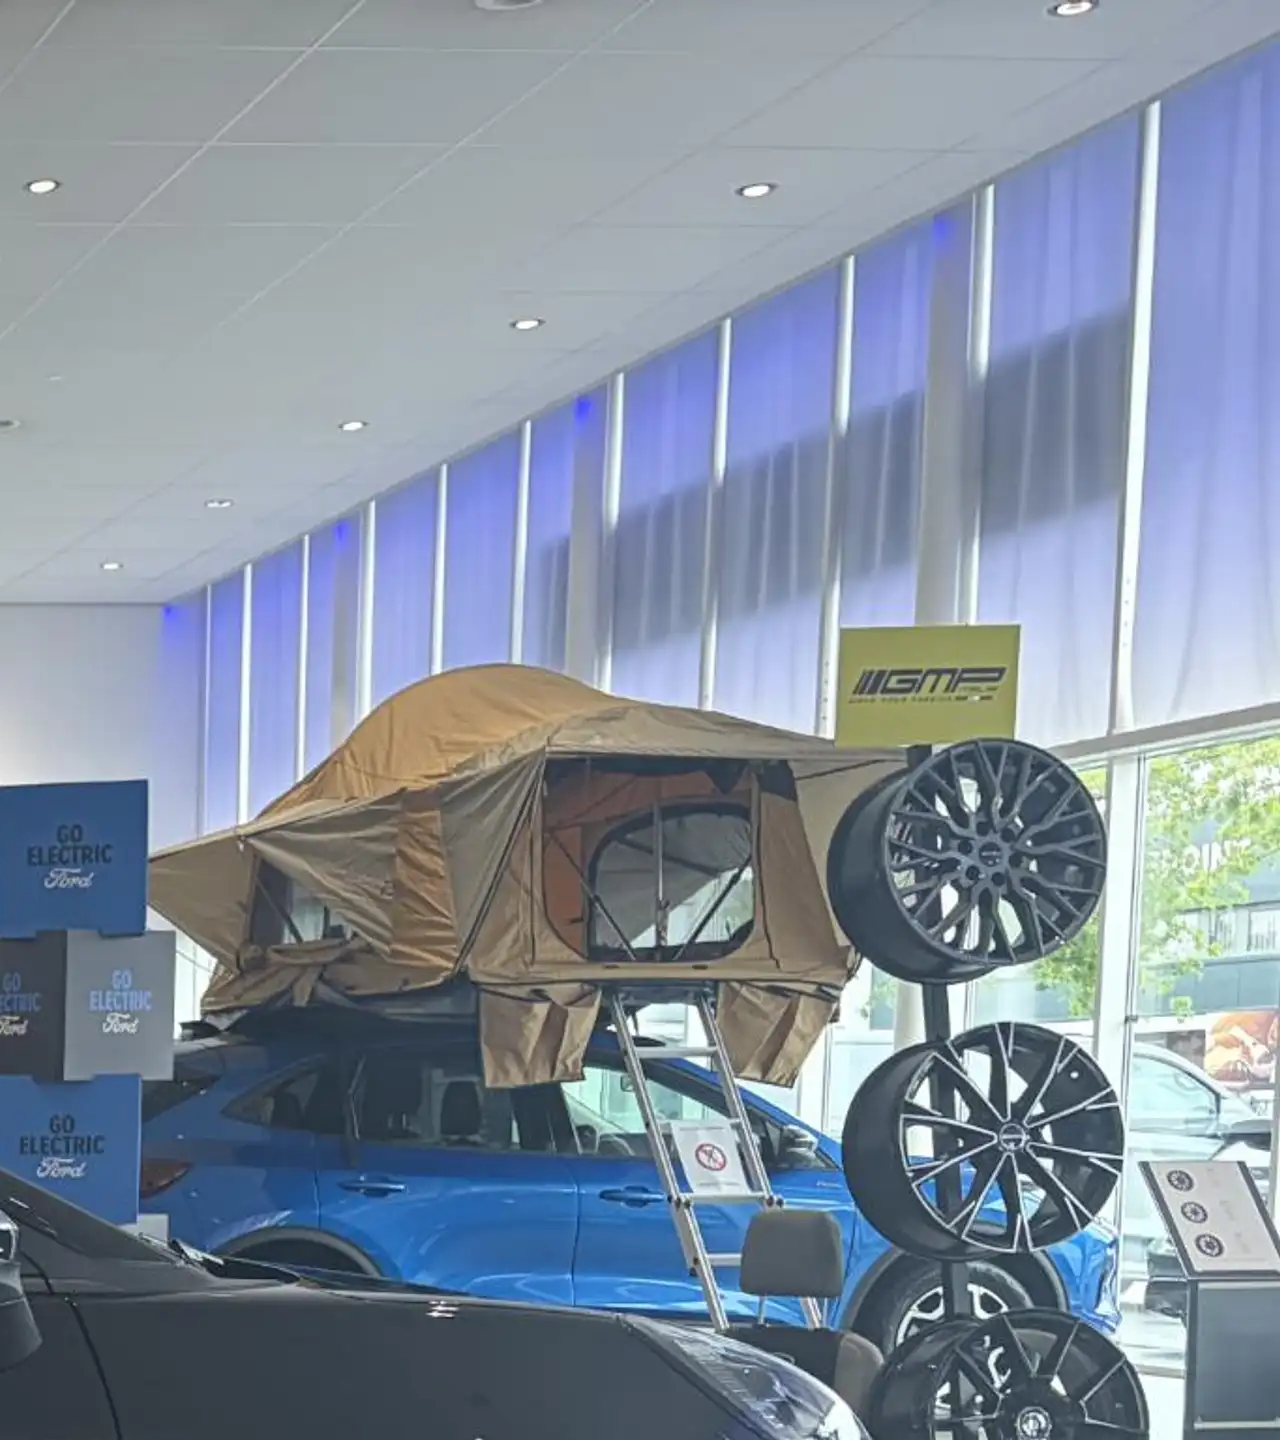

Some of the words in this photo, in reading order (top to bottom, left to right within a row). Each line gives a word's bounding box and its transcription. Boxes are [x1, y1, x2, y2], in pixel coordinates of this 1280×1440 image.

[56, 823, 83, 843] GO
[27, 844, 113, 866] ELECTRIC
[44, 867, 95, 889] Ford
[2, 972, 22, 992] GO
[111, 969, 133, 989] GO
[89, 989, 153, 1012] ELECTRIC
[102, 1012, 140, 1034] Ford
[49, 1113, 76, 1134] GO
[20, 1135, 105, 1155] ELECTRIC
[36, 1156, 88, 1179] Ford
